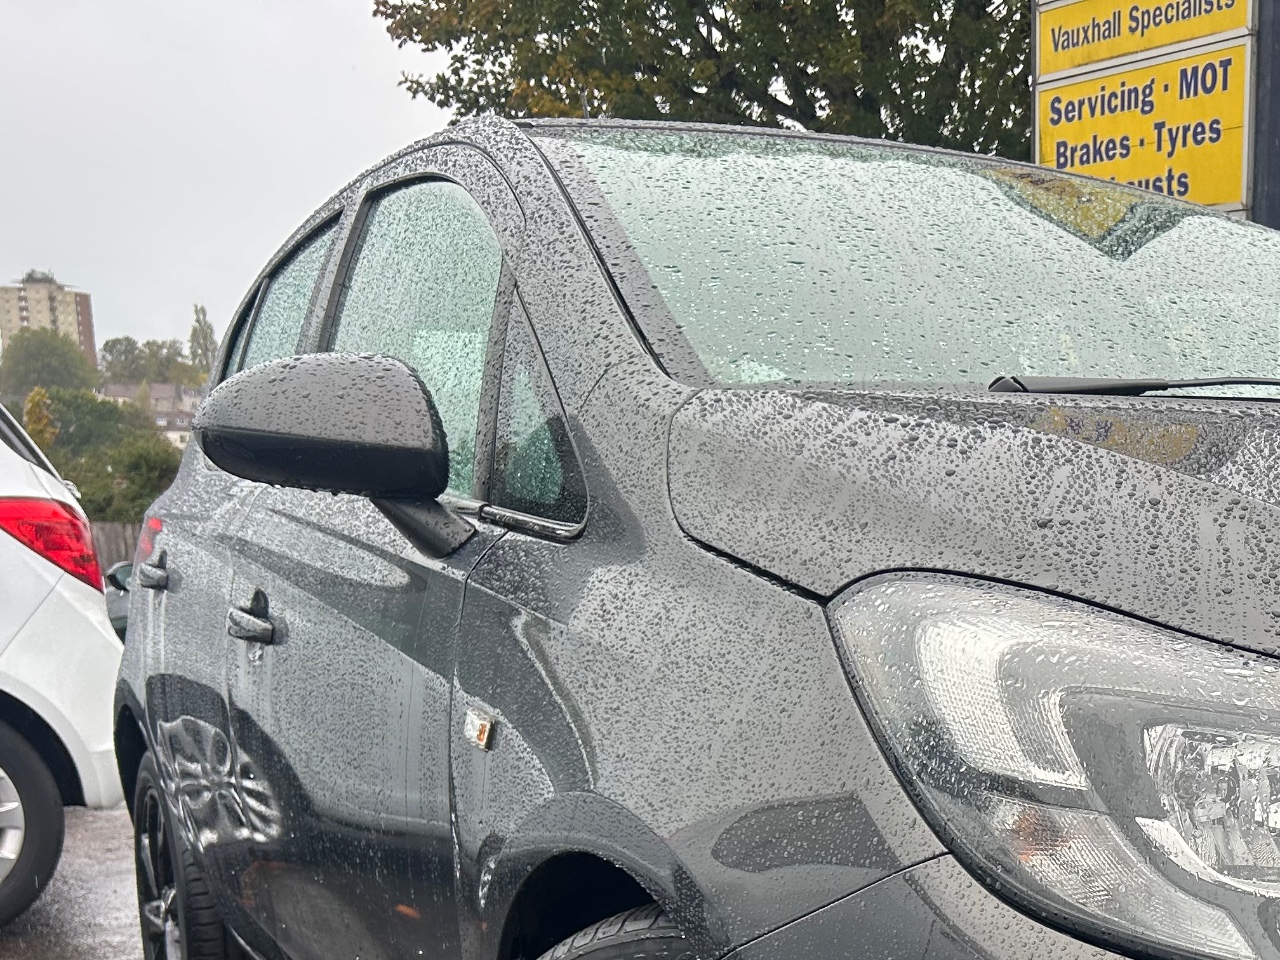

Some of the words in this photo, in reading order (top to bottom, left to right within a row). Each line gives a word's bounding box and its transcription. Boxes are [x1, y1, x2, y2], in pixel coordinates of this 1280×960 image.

[1051, 10, 1121, 53] Vauxhall
[1049, 78, 1155, 126] Servicing
[1179, 58, 1232, 100] MOT
[1055, 134, 1130, 170] Brakes
[1154, 118, 1222, 158] Tyres
